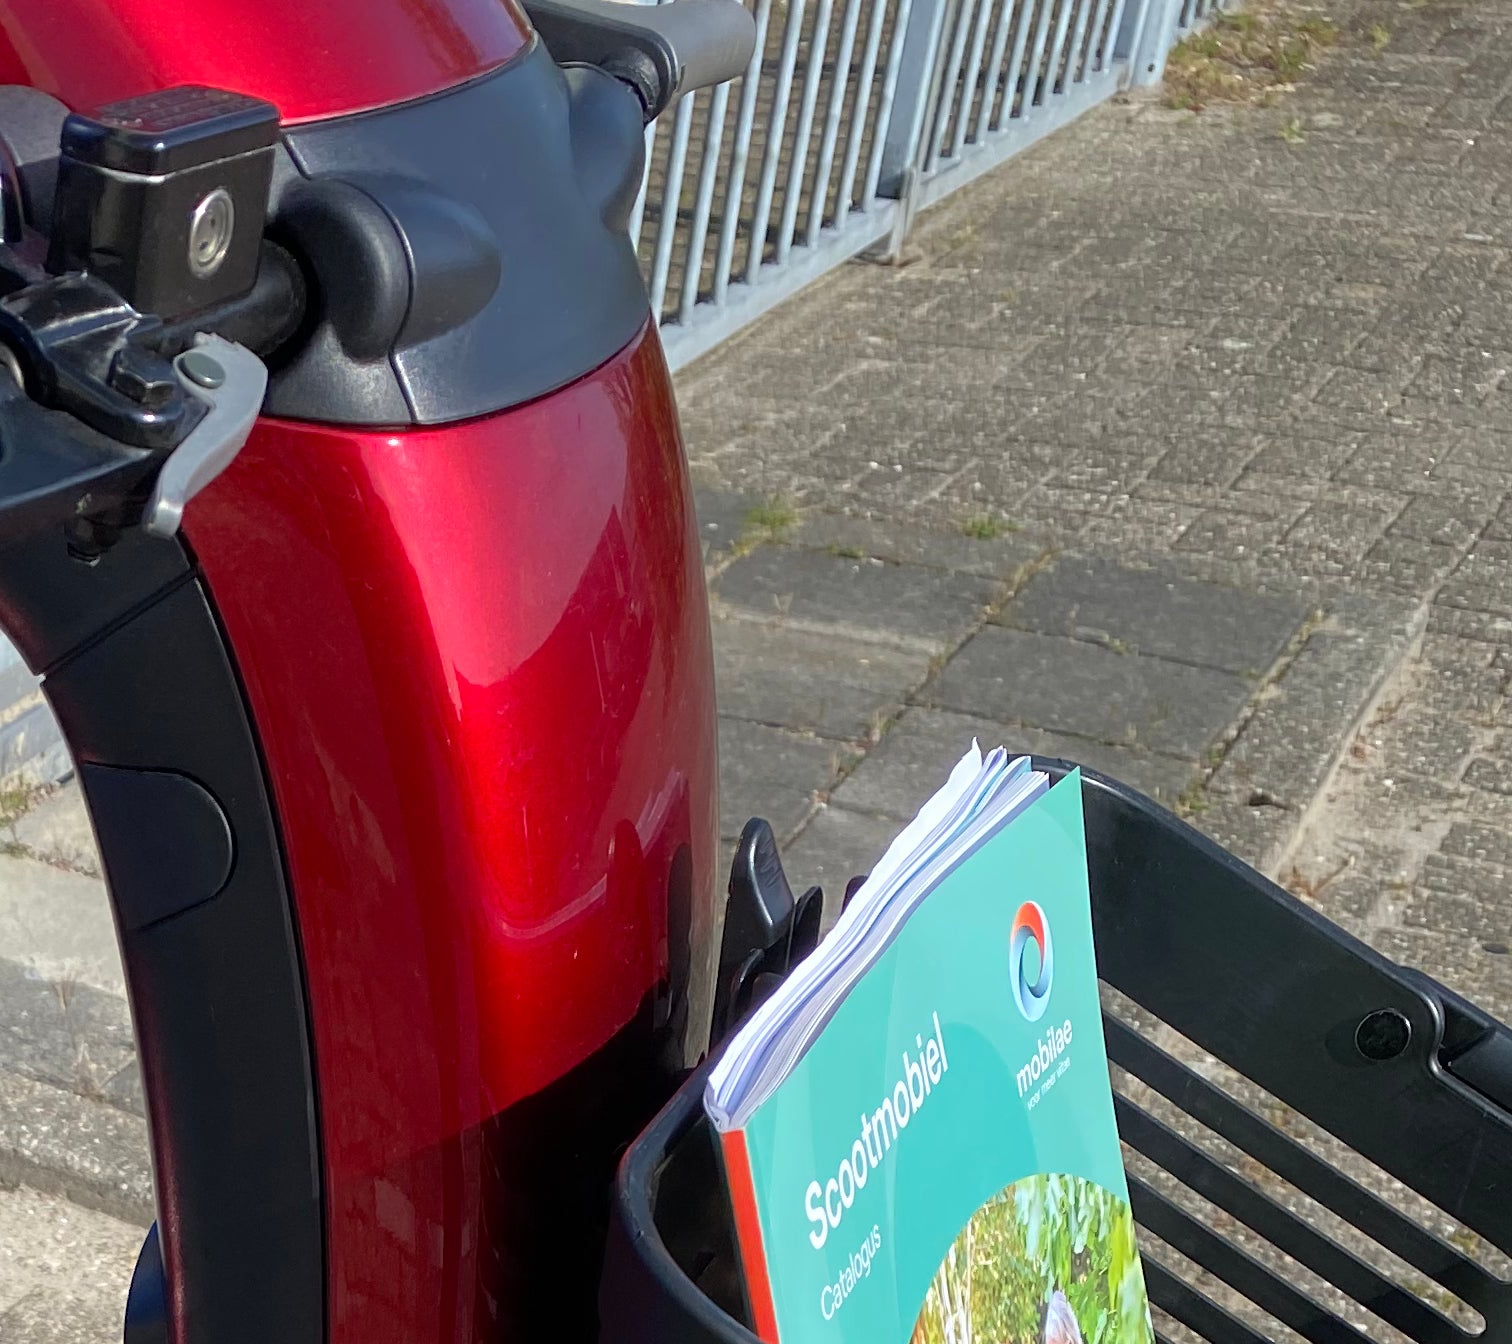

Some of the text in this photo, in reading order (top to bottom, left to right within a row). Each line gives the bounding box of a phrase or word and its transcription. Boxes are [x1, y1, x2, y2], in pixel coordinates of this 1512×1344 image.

[1016, 1019, 1073, 1098] mobilae
[805, 1010, 948, 1250] Scootmobiel
[820, 1224, 882, 1321] Catalogus
